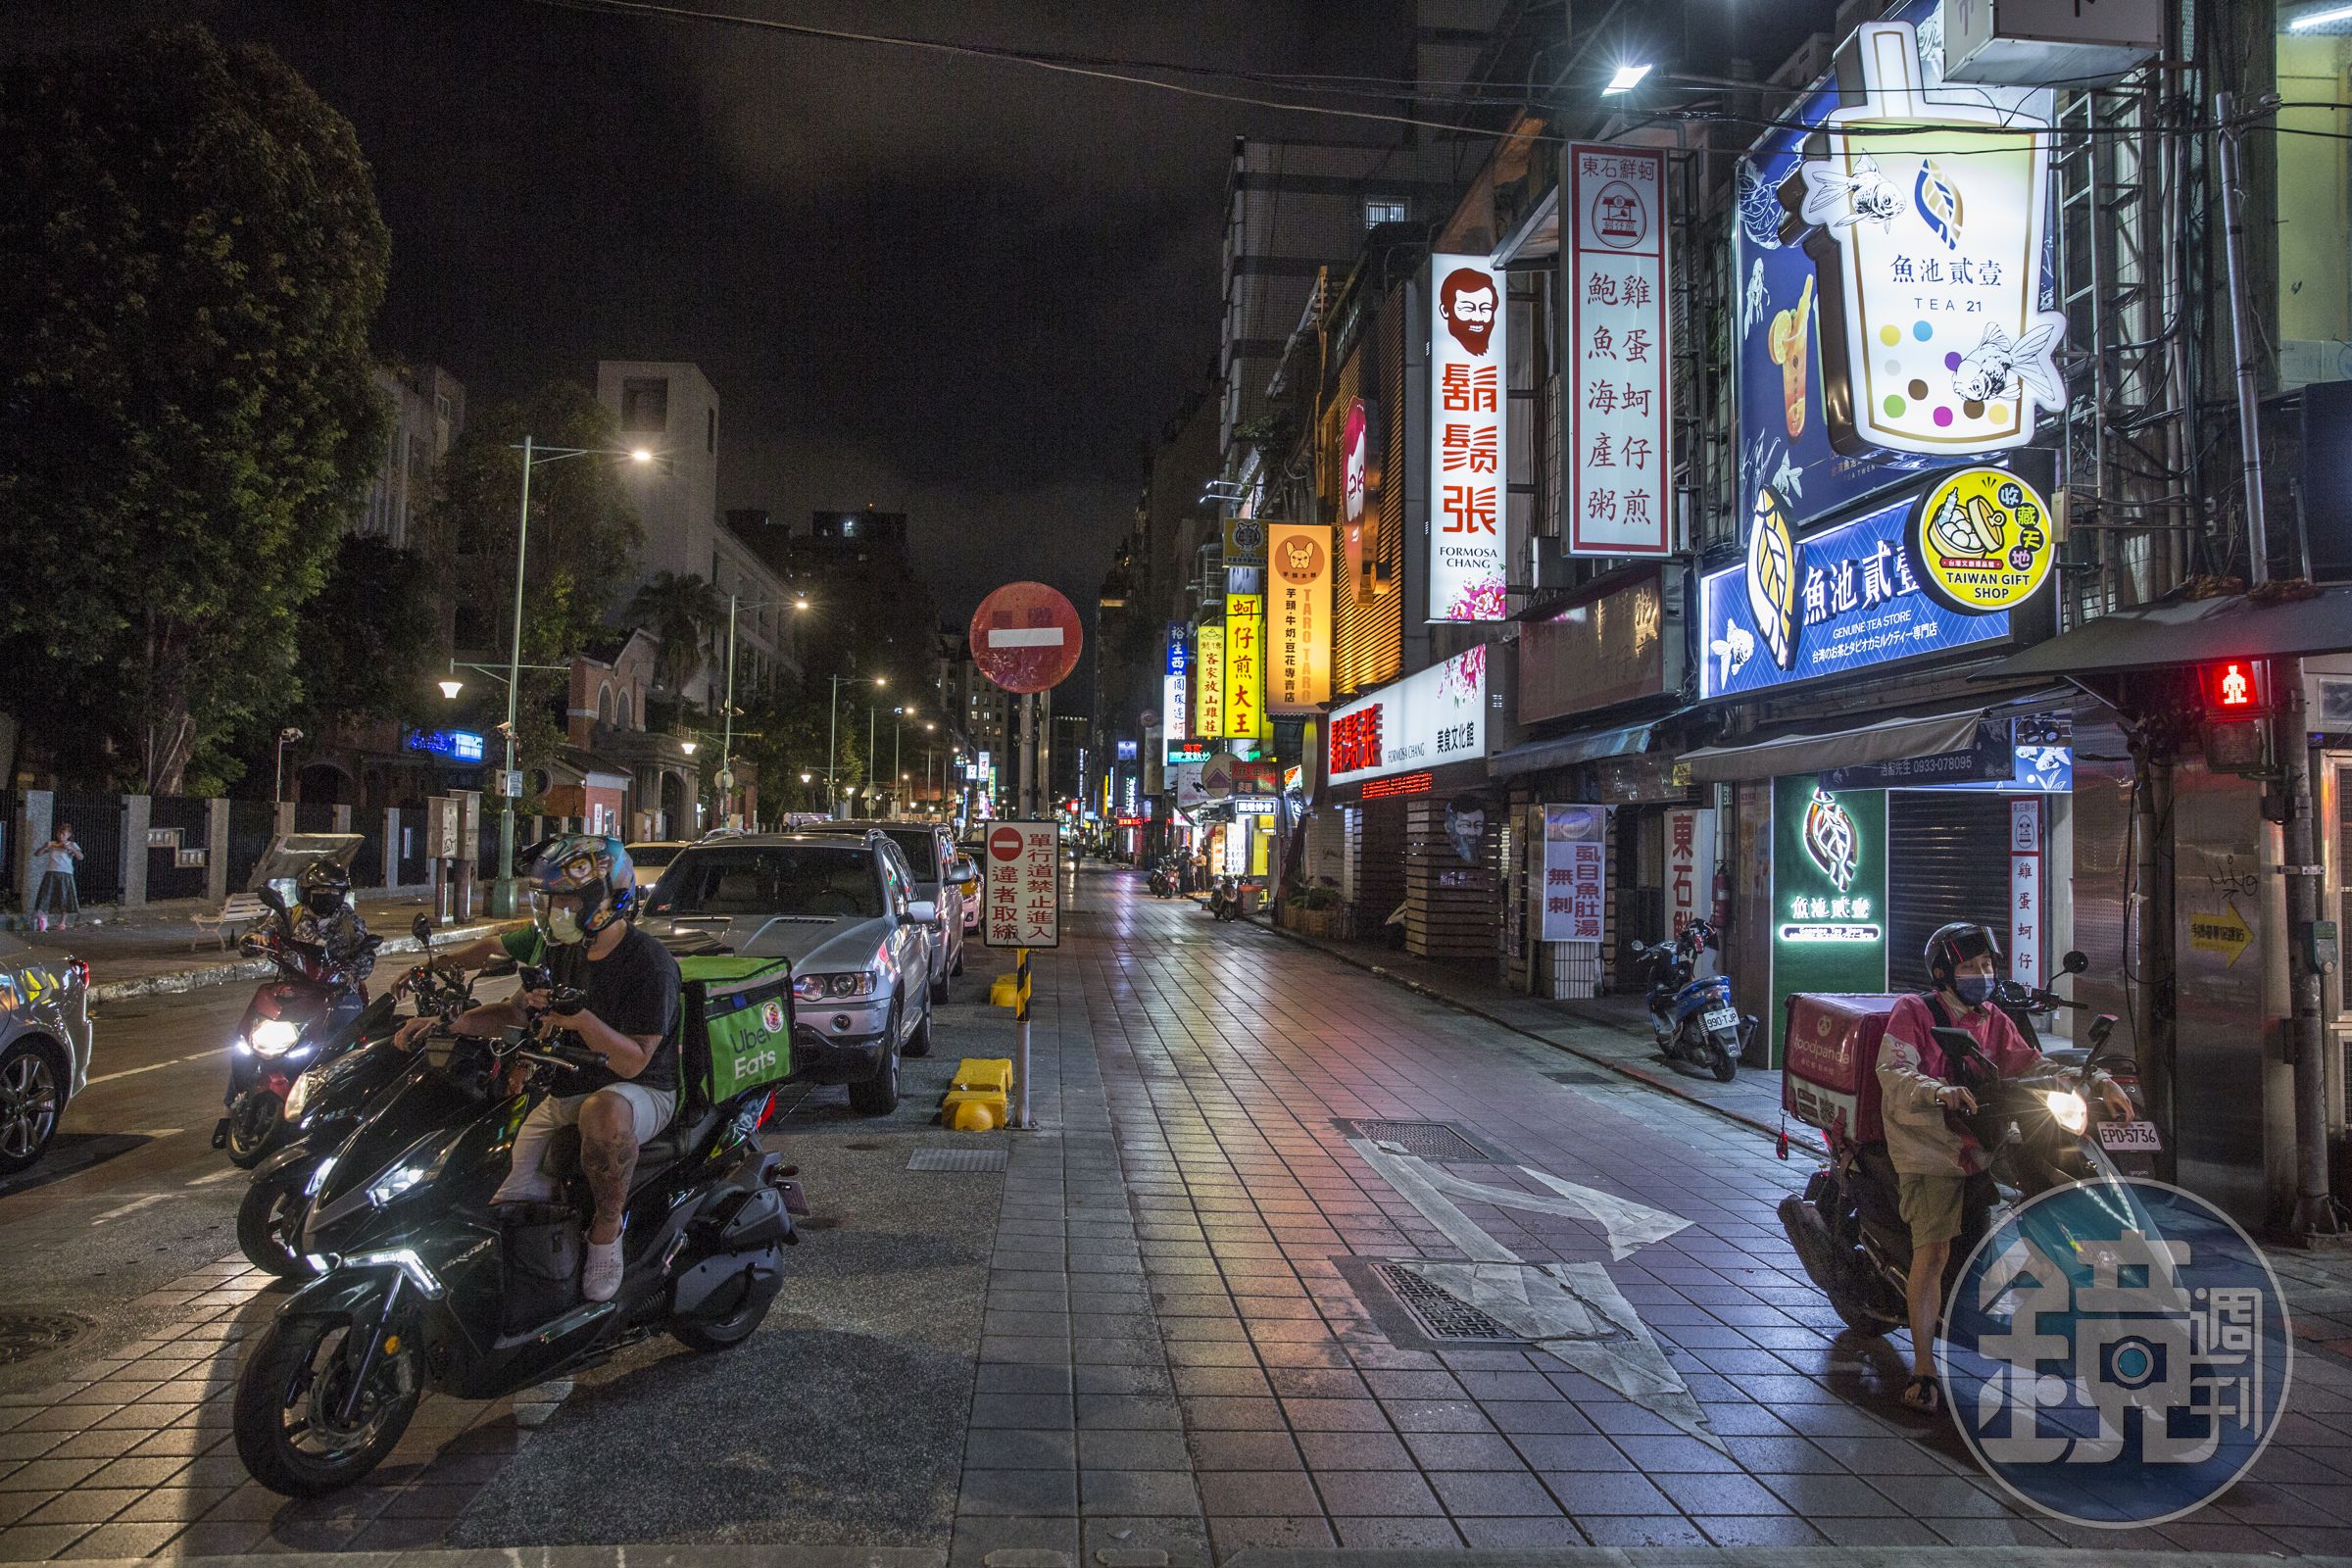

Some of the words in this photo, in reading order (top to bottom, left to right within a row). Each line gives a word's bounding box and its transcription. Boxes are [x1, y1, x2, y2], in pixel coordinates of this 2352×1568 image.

[1582, 156, 1655, 180] 東石鮮蚵
[1889, 254, 2002, 286] 魚池貳壹
[1914, 299, 1956, 312] TEA
[1966, 299, 1983, 312] 21
[1587, 271, 1619, 521] 鮑魚海產粥
[1620, 274, 1652, 525] 雞蛋蚵仔煎
[1443, 364, 1497, 536] 鬍鬚張
[2000, 487, 2041, 567] 收藏天地
[1440, 546, 1497, 558] FORMOSA
[1446, 558, 1491, 568] CHANG
[1946, 572, 1997, 584] TAIWAN
[2001, 574, 2030, 585] GIFT
[1975, 588, 2009, 598] SHOP
[1302, 589, 1312, 643] TARO
[1833, 621, 1866, 640] GENUINE
[1867, 618, 1883, 631] TEA
[1884, 610, 1912, 626] STORE
[1233, 600, 1255, 733] 蚵仔煎大王
[1301, 649, 1311, 703] TARO
[1388, 745, 1407, 762] FORMOSA
[1407, 742, 1425, 759] CHANG
[1437, 721, 1474, 754] 美食文化館
[1027, 833, 1054, 938] 單行道禁止進入
[1548, 868, 1573, 913] 無刺
[1575, 845, 1600, 937] 虱目魚肚湯
[992, 865, 1018, 940] 違者取締
[735, 1050, 776, 1080] Eats
[1795, 1034, 1850, 1064] foodpanda
[2100, 1128, 2156, 1144] EPD-5736
